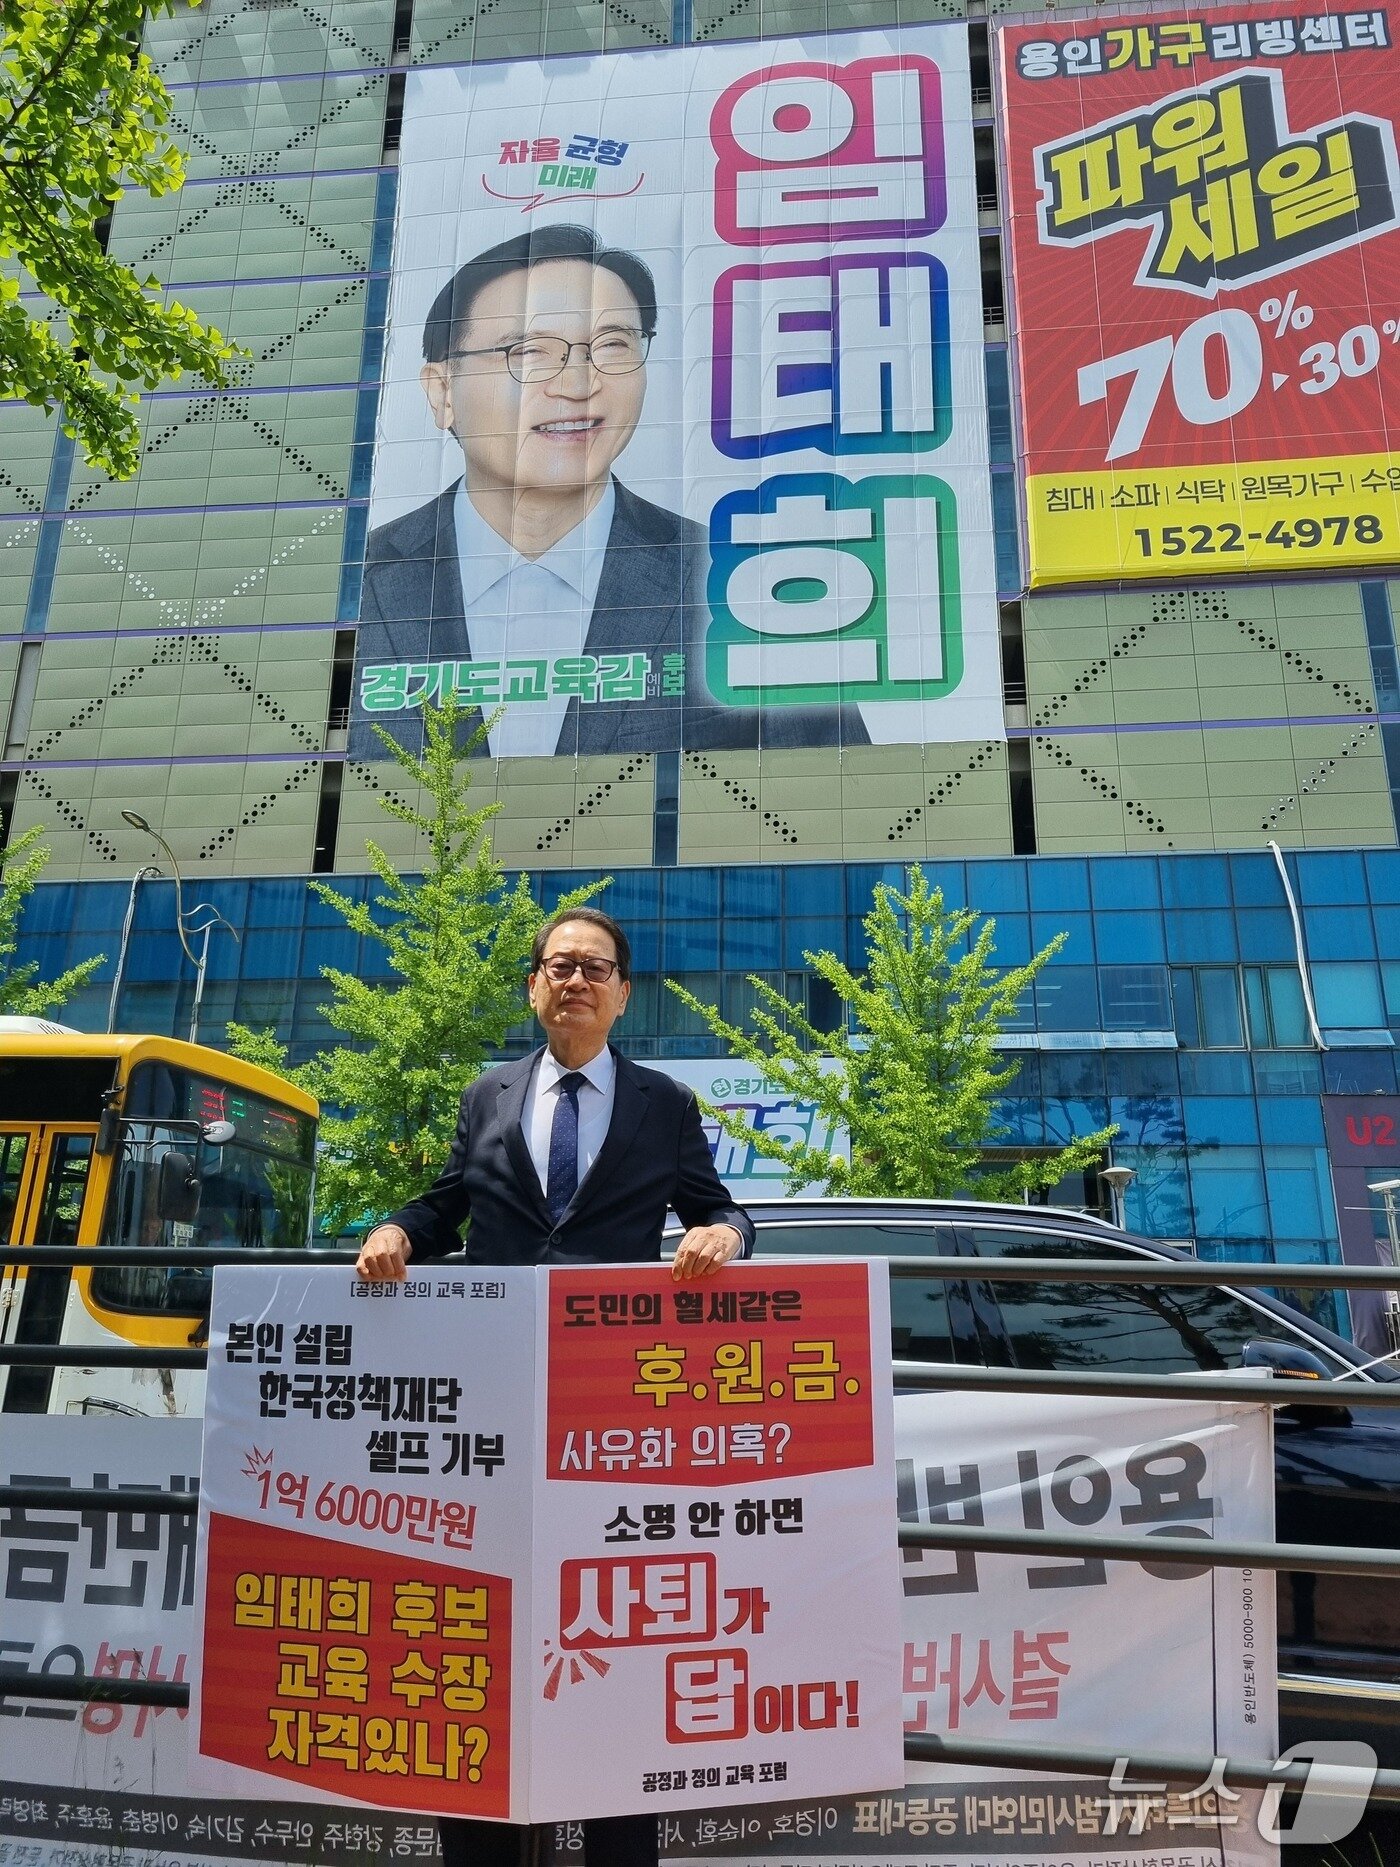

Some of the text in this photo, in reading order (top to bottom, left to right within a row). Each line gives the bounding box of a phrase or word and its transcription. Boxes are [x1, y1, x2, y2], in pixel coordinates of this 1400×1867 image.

[1020, 12, 1388, 77] 용인가구리빙센터
[499, 134, 630, 167] 자율 균형
[1050, 85, 1247, 226] 파워
[538, 164, 598, 190] 미래
[1157, 131, 1360, 274] 세일
[720, 62, 950, 695] 임태희
[1046, 486, 1094, 512] 침대
[1110, 483, 1160, 509] 소파
[1175, 479, 1226, 504] 식탁
[1241, 471, 1345, 499] 원목가구
[1134, 514, 1384, 557] 1522-4978
[361, 653, 652, 712] 경기도교육감
[662, 652, 686, 697] 후보
[1345, 1114, 1397, 1146] U2
[404, 1281, 431, 1299] 정의
[436, 1281, 465, 1299] 교육
[564, 1290, 802, 1327] 도민의 혈세같은
[226, 1323, 353, 1366] 본인 설립
[259, 1370, 463, 1424] 한국정책재단
[632, 1340, 860, 1407] 후.원.금.
[366, 1430, 506, 1477] 셀프 기부
[559, 1422, 792, 1471] 사유화 의혹?
[257, 1469, 478, 1552] 1억 6000만원
[604, 1498, 804, 1543] 소명 안 하면
[235, 1573, 489, 1641] 임태희 후보
[1242, 1587, 1254, 1649] 5000-900
[277, 1642, 492, 1712] 교육 수장
[267, 1708, 489, 1783] 자격있나?
[642, 1761, 788, 1793] 공정과 정의 교육 포럼
